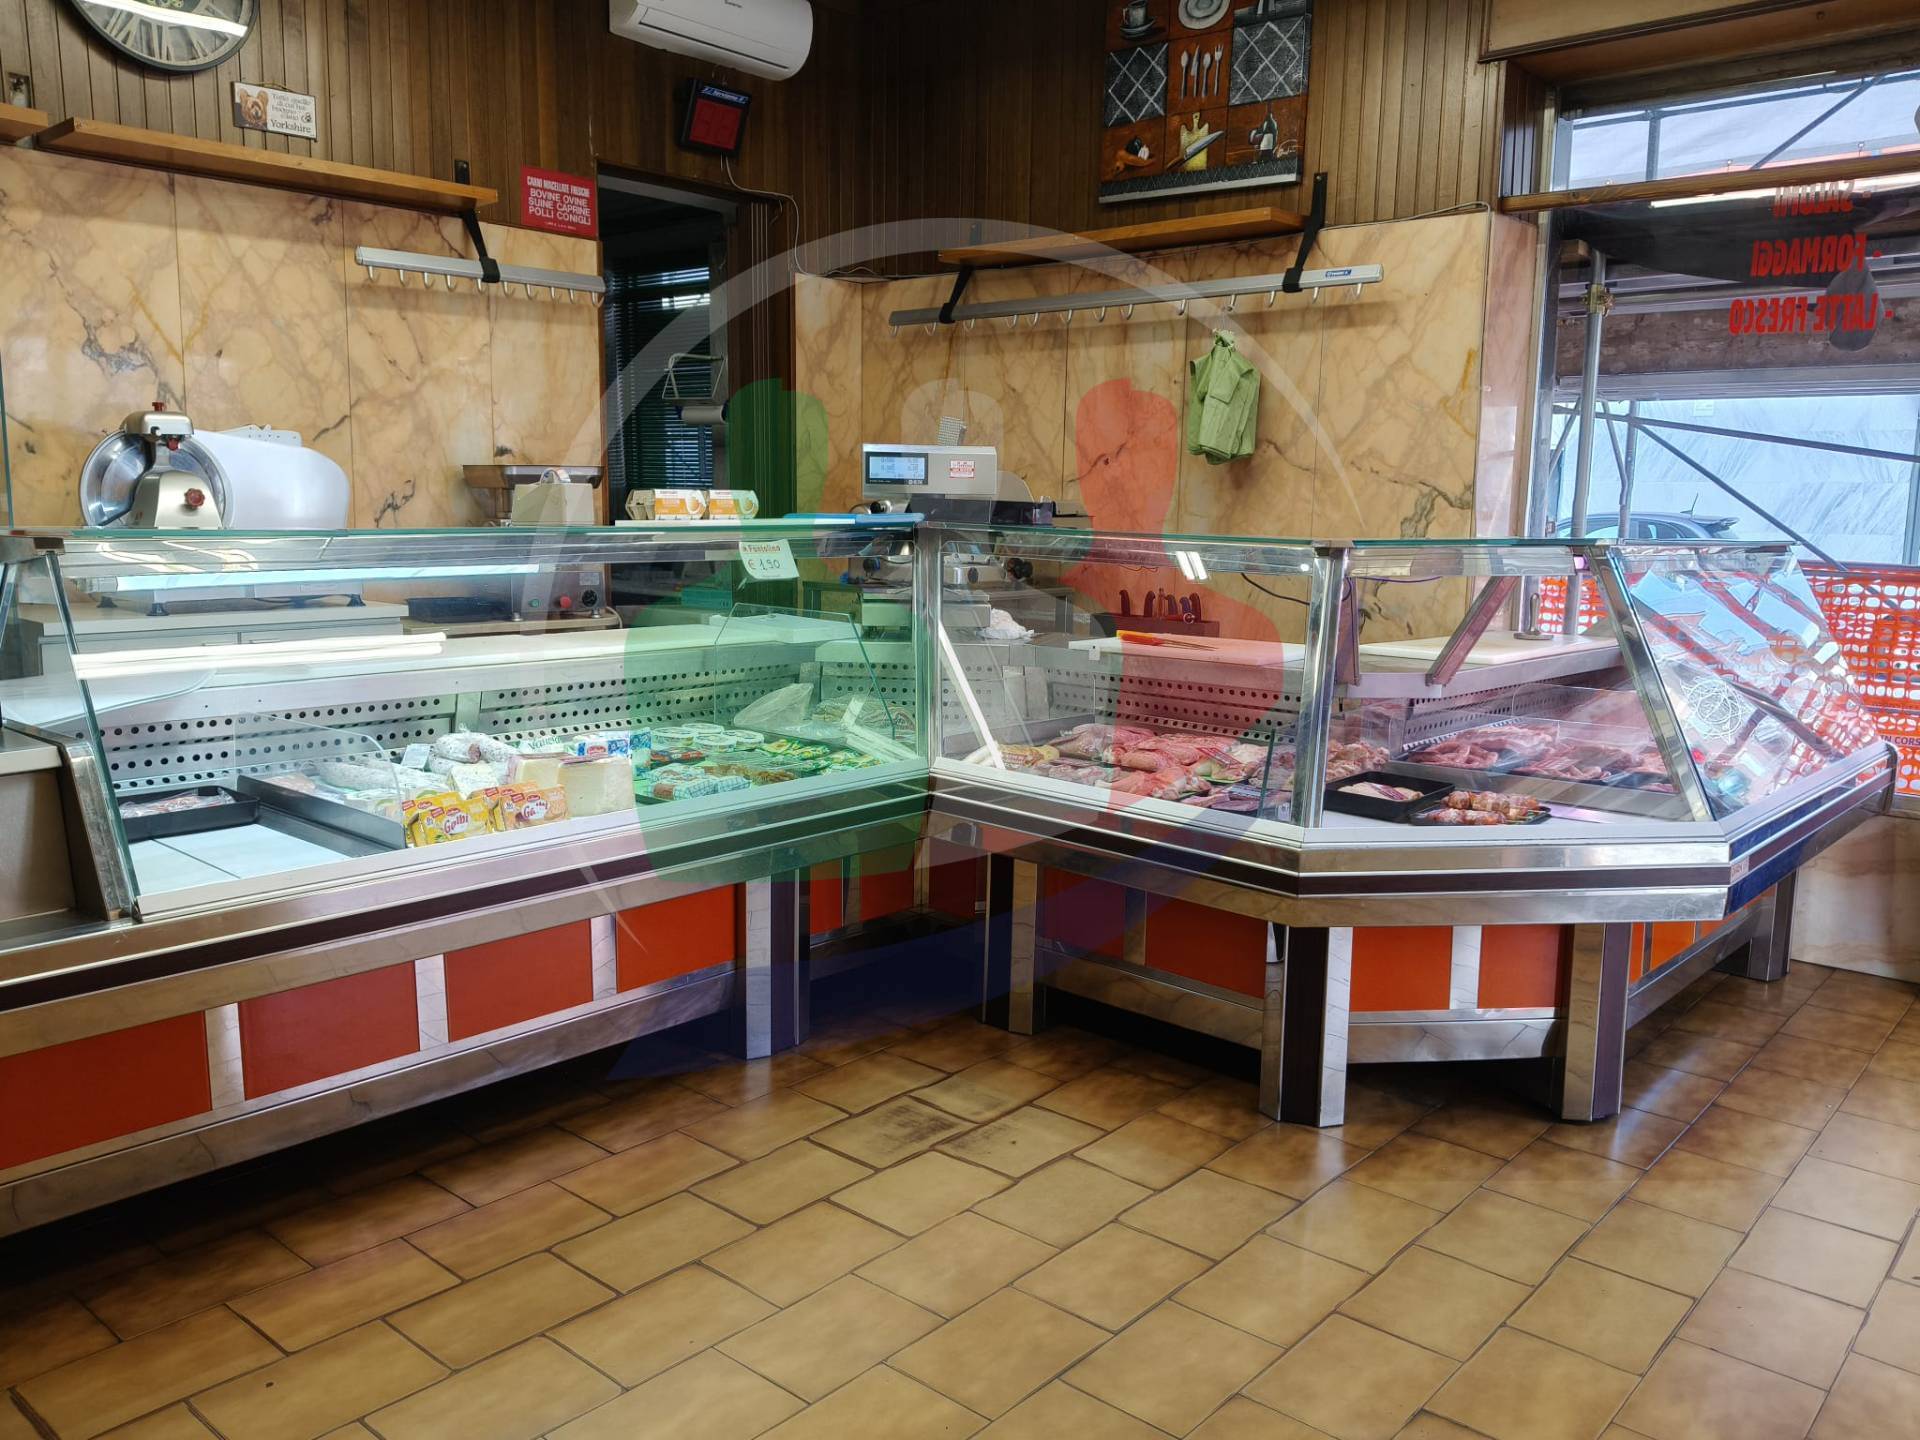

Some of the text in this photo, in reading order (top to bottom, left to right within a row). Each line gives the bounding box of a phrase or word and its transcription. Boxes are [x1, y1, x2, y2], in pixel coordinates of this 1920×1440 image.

[271, 119, 313, 133] Yorkshire
[528, 197, 592, 217] SUINE CAPRINE
[530, 188, 588, 207] BOVINE OVINE
[529, 206, 591, 225] POLLI CONIGLI
